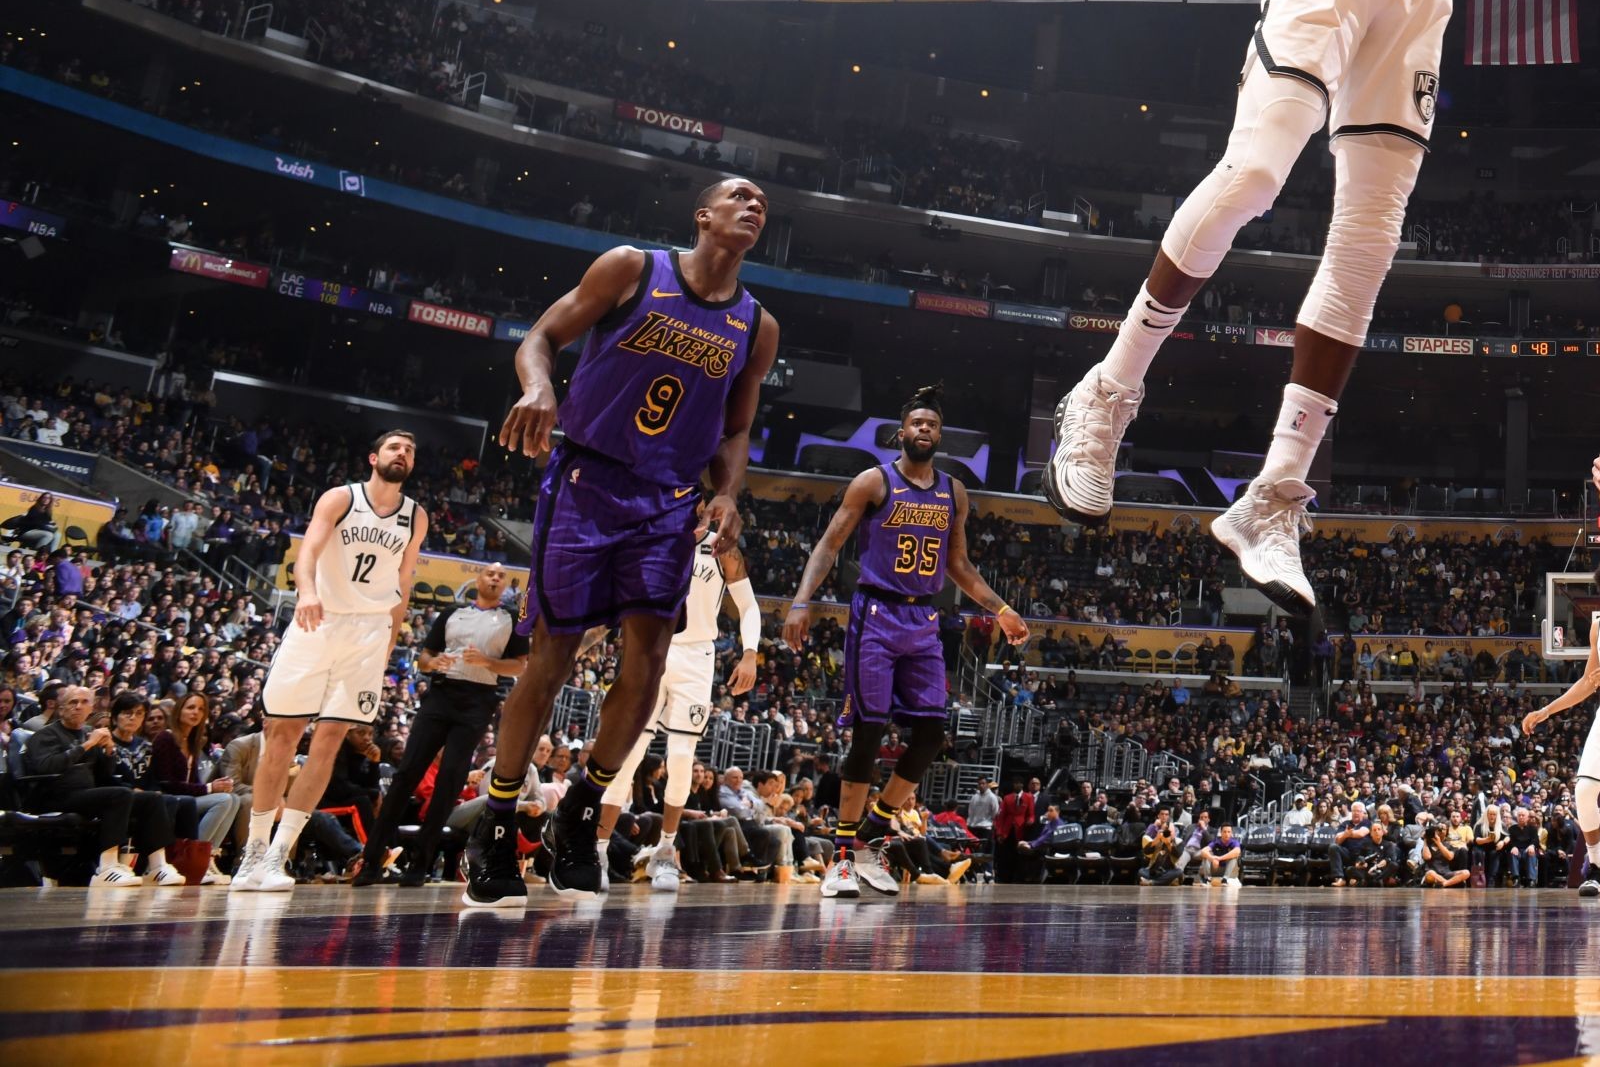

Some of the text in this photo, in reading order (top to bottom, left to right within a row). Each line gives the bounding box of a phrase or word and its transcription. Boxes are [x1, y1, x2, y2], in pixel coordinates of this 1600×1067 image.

[634, 105, 704, 135] TOYOTA
[275, 157, 315, 180] wish
[28, 220, 57, 237] NBA
[281, 272, 305, 287] LAC
[1551, 268, 1567, 278] TEXT
[279, 284, 305, 299] CLE
[368, 301, 394, 316] NBA
[411, 303, 490, 334] TOSHIBA
[725, 313, 748, 332] wish
[1088, 318, 1122, 331] TOYO
[666, 317, 738, 349] LOS ANGELES
[1205, 326, 1246, 336] LAL BKN
[617, 310, 735, 379] LAKERS
[1363, 338, 1398, 349] ELTA
[1404, 337, 1471, 353] STAPLES
[1530, 343, 1549, 355] 48
[634, 373, 685, 436] 9
[881, 501, 950, 532] LAKERS
[341, 526, 404, 556] BROOKLYN
[894, 534, 942, 576] 35
[351, 551, 377, 584] 12
[495, 825, 505, 840] R
